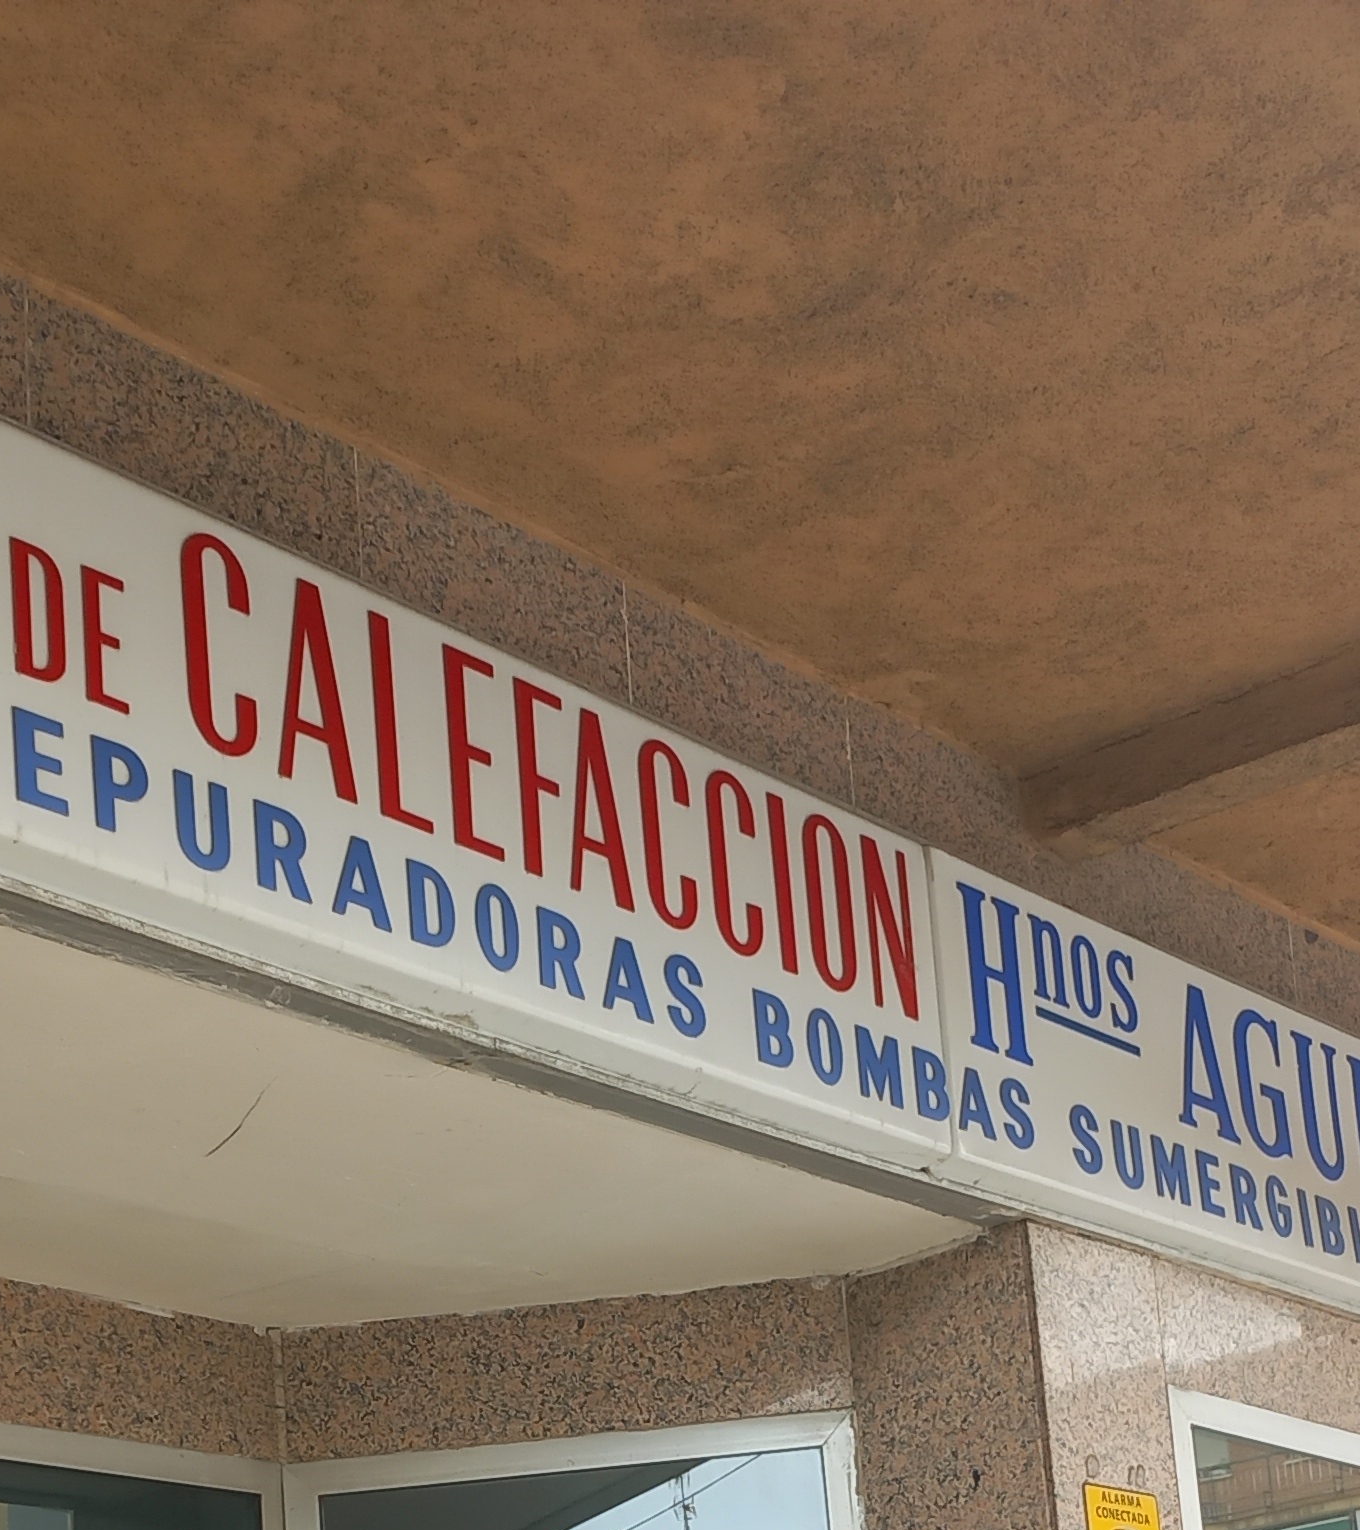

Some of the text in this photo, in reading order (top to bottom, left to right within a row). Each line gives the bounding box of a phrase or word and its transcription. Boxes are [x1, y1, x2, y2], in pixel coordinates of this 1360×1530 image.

[8, 535, 130, 715] DE
[180, 532, 920, 1021] CALEFACCION
[755, 986, 1036, 1151] BOMBAS
[1095, 1505, 1151, 1526] CONECTADA
[1101, 1490, 1143, 1508] ALARMA
